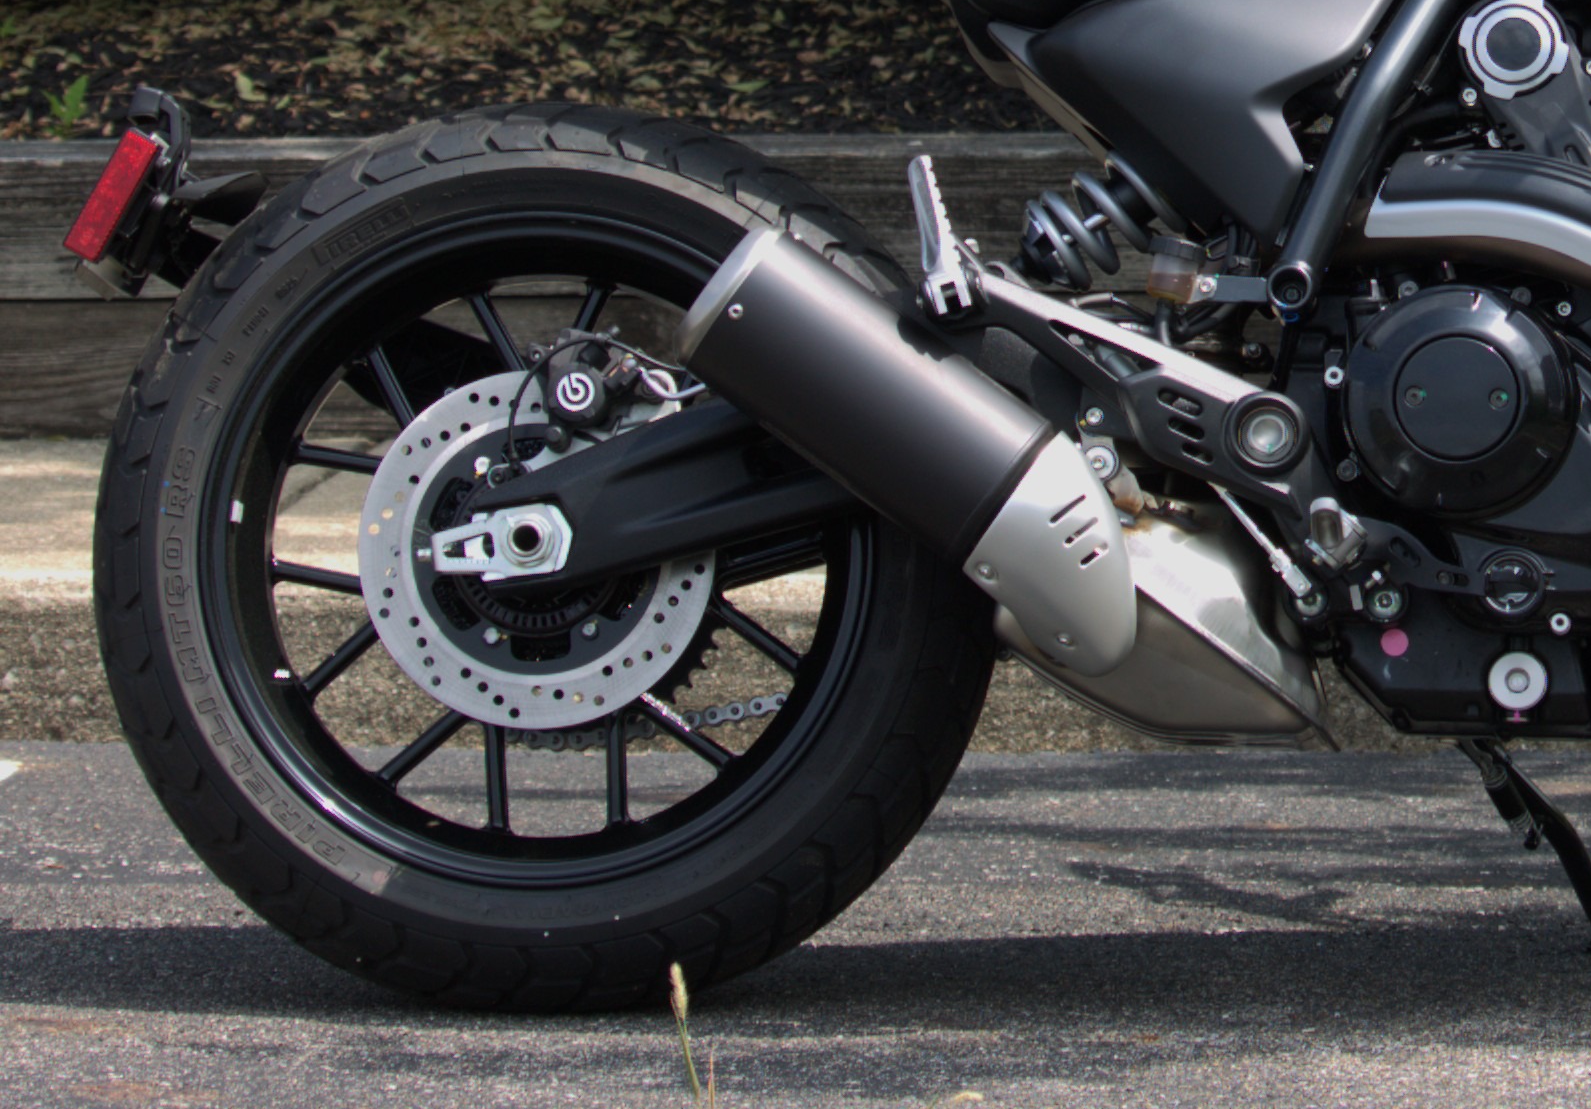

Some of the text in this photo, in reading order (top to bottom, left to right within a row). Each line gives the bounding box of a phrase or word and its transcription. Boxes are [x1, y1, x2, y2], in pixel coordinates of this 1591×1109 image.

[163, 446, 346, 866] PIRELLI MT60 RS
